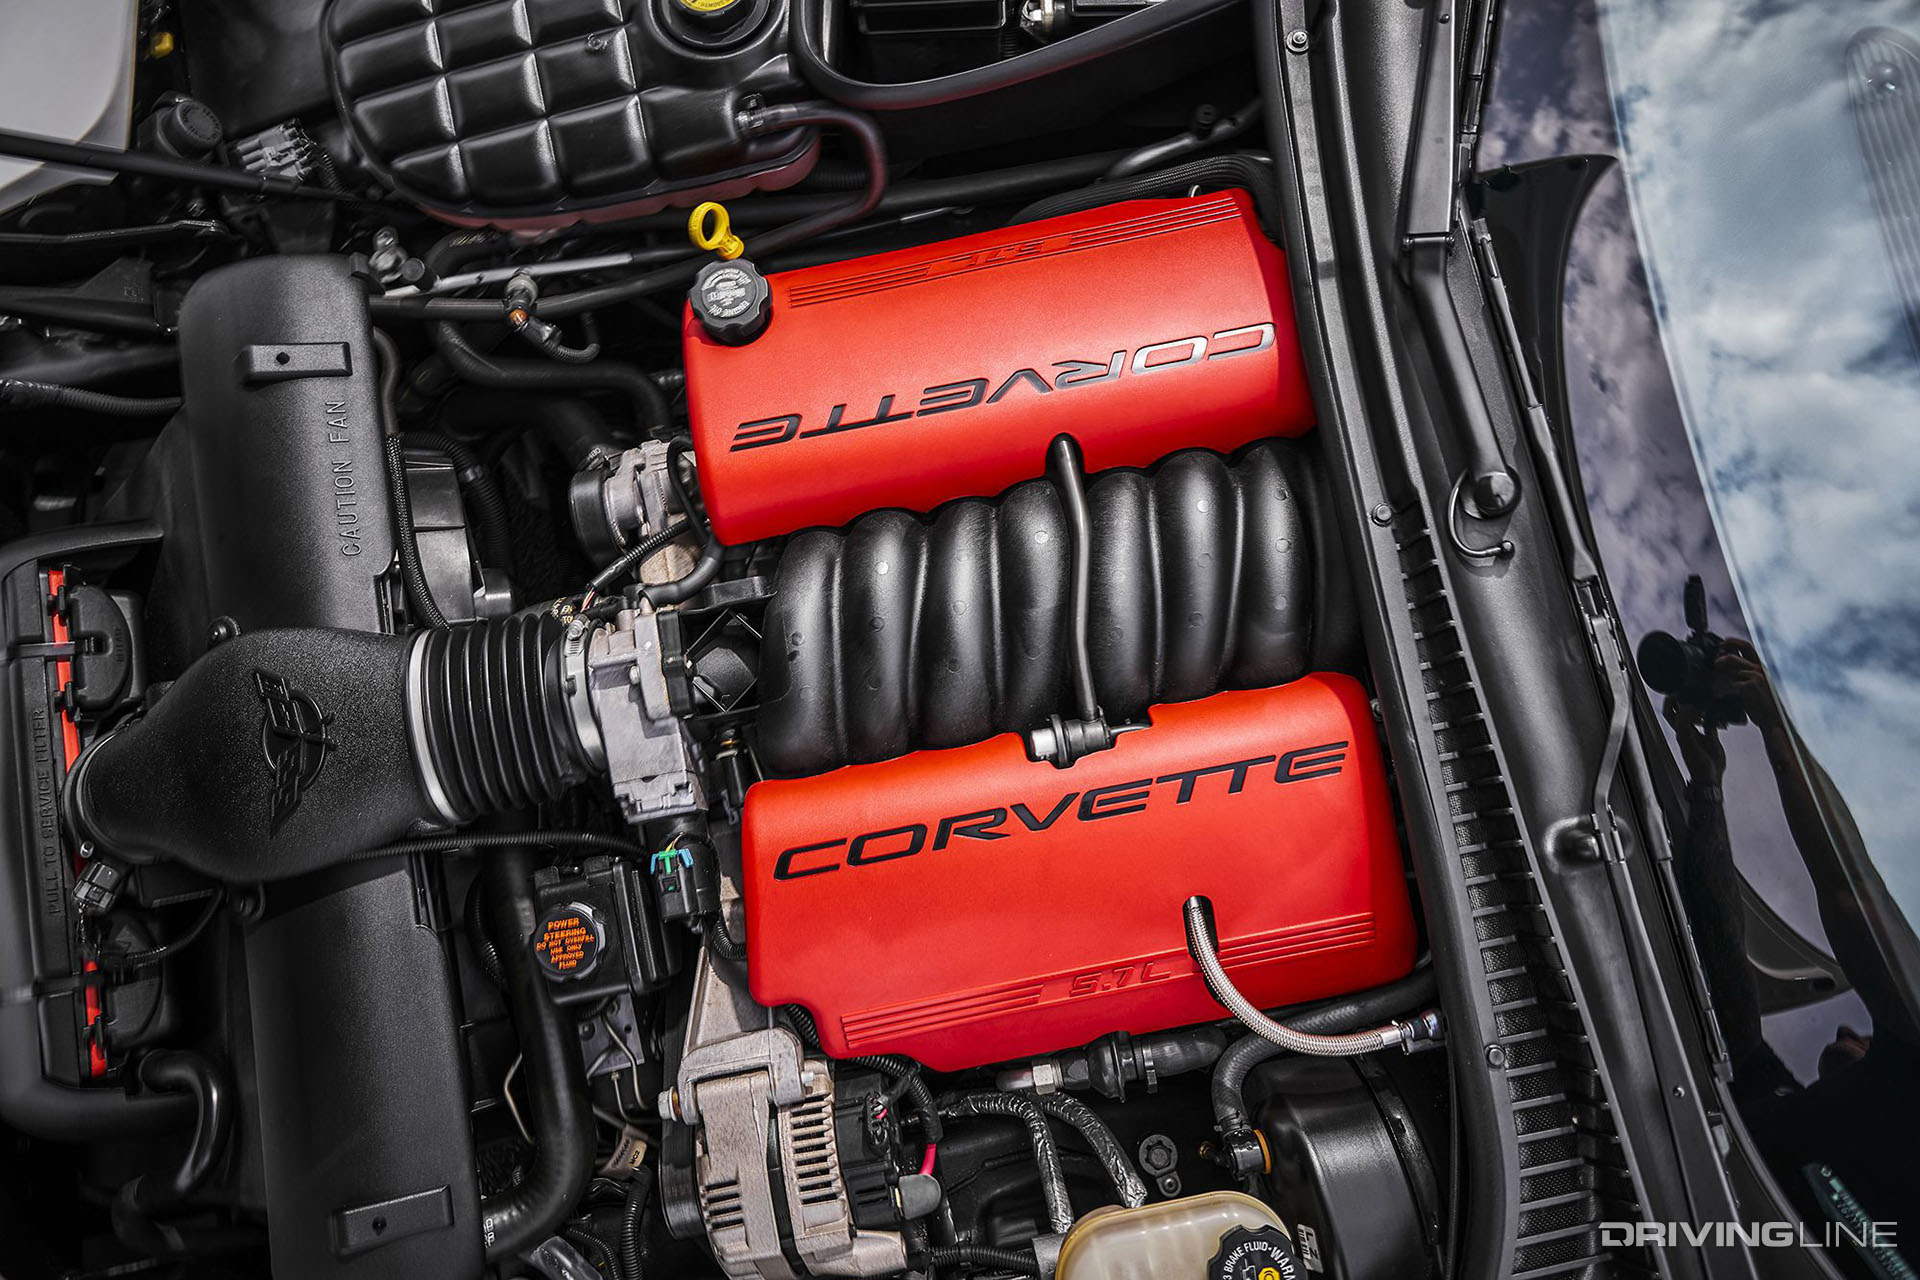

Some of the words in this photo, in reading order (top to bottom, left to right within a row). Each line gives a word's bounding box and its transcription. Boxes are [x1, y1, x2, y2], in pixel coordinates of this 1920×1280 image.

[707, 304, 722, 316] OIL
[720, 300, 749, 318] ENGINE
[730, 322, 1275, 451] CORVETTE
[324, 400, 350, 443] FAN
[332, 460, 362, 557] CAUTION
[33, 709, 50, 763] FILTER
[37, 770, 55, 838] SERVICE
[774, 741, 1349, 880] CORVETTE
[43, 845, 57, 869] TO
[45, 872, 61, 915] PULL
[543, 927, 587, 942] STEERING
[547, 918, 580, 930] POWER
[536, 942, 547, 952] DO
[549, 939, 562, 949] NOT
[550, 951, 585, 964] APPROVED
[566, 944, 582, 952] ONLY
[558, 960, 577, 970] FLUID
[1069, 961, 1171, 997] 5.7L
[1224, 1246, 1245, 1273] BRAKE
